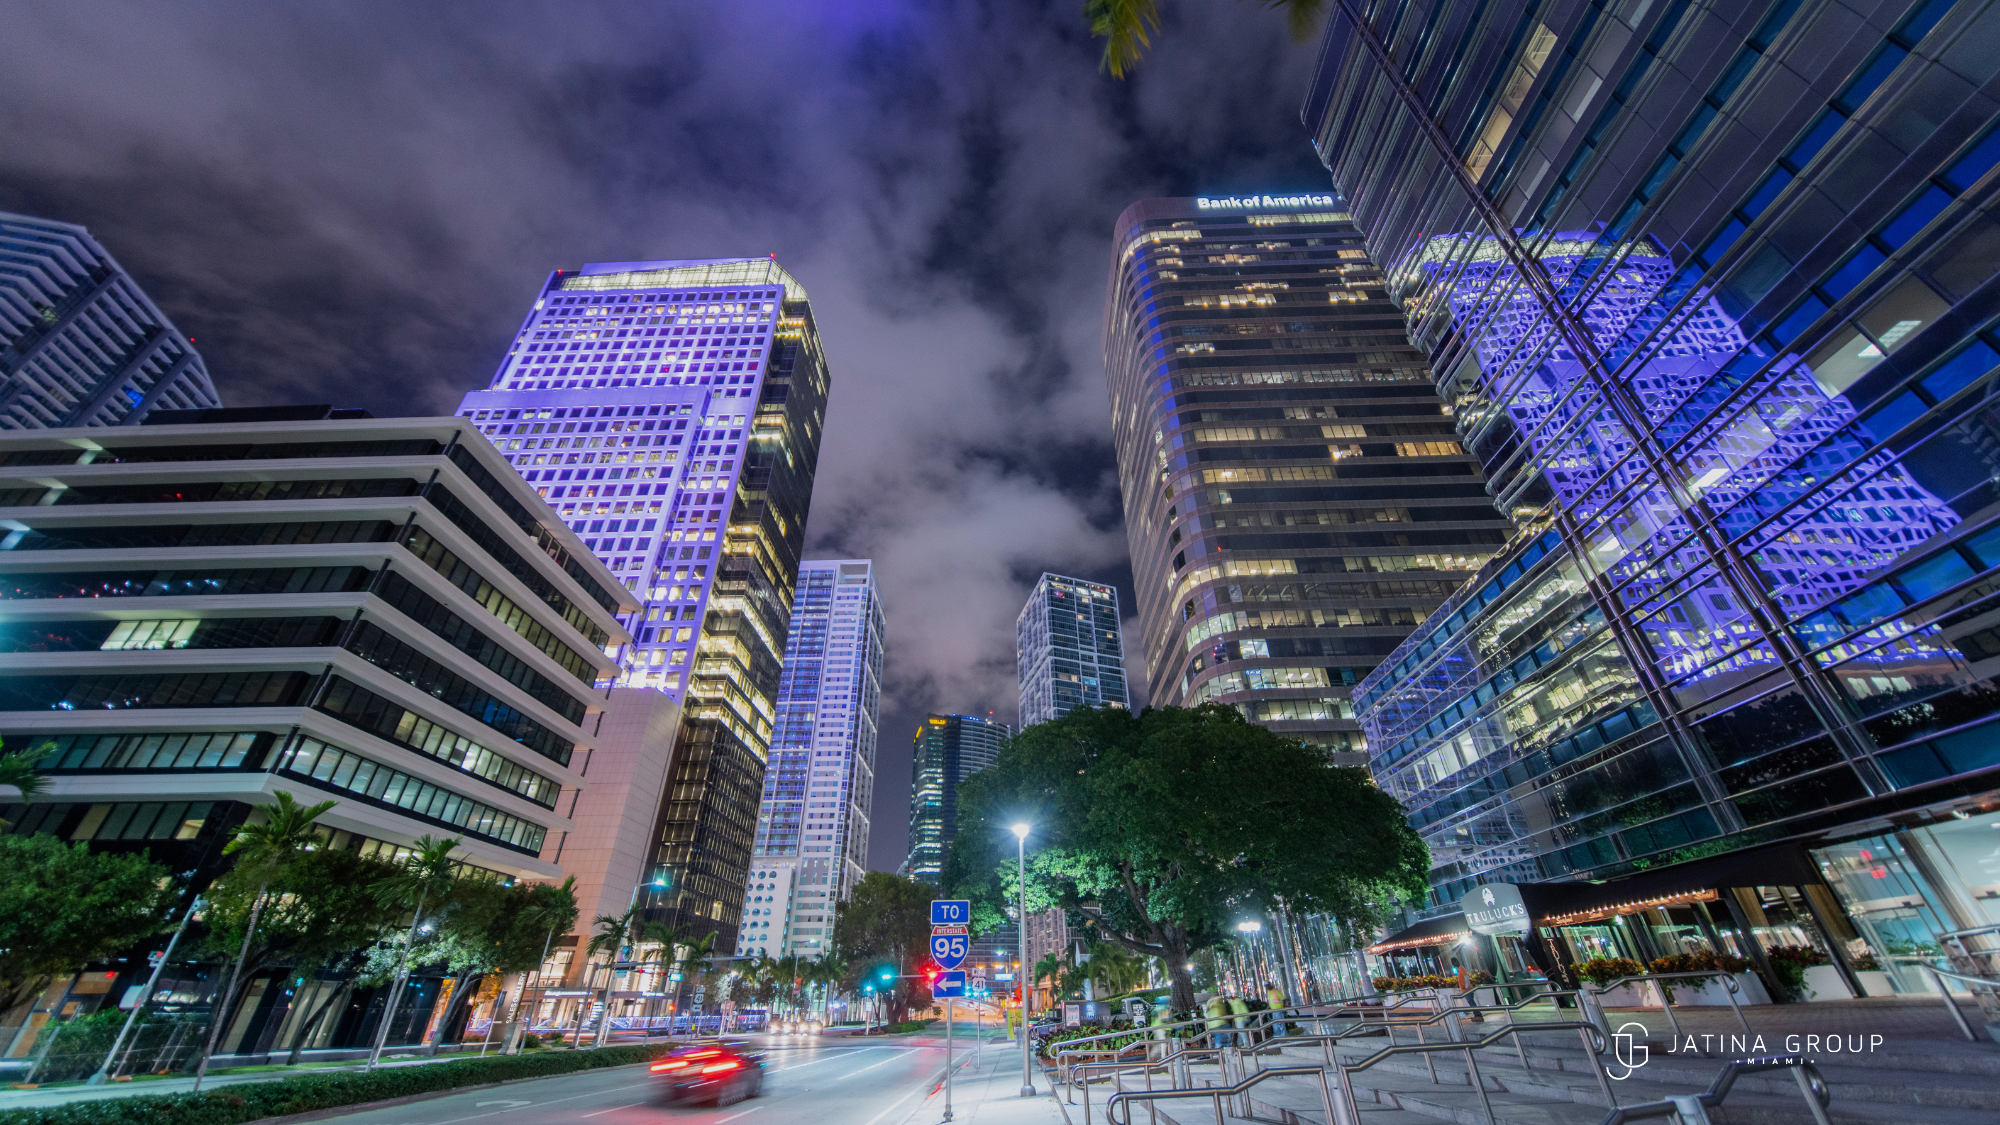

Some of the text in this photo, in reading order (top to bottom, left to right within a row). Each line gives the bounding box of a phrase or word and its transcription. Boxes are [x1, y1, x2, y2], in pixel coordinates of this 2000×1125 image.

[1197, 194, 1333, 208] Bank of America
[941, 904, 960, 919] TO
[1466, 903, 1525, 924] TRULUCK'S
[934, 937, 965, 959] 95
[974, 980, 984, 990] 41
[505, 972, 527, 1024] SALES GALLERY
